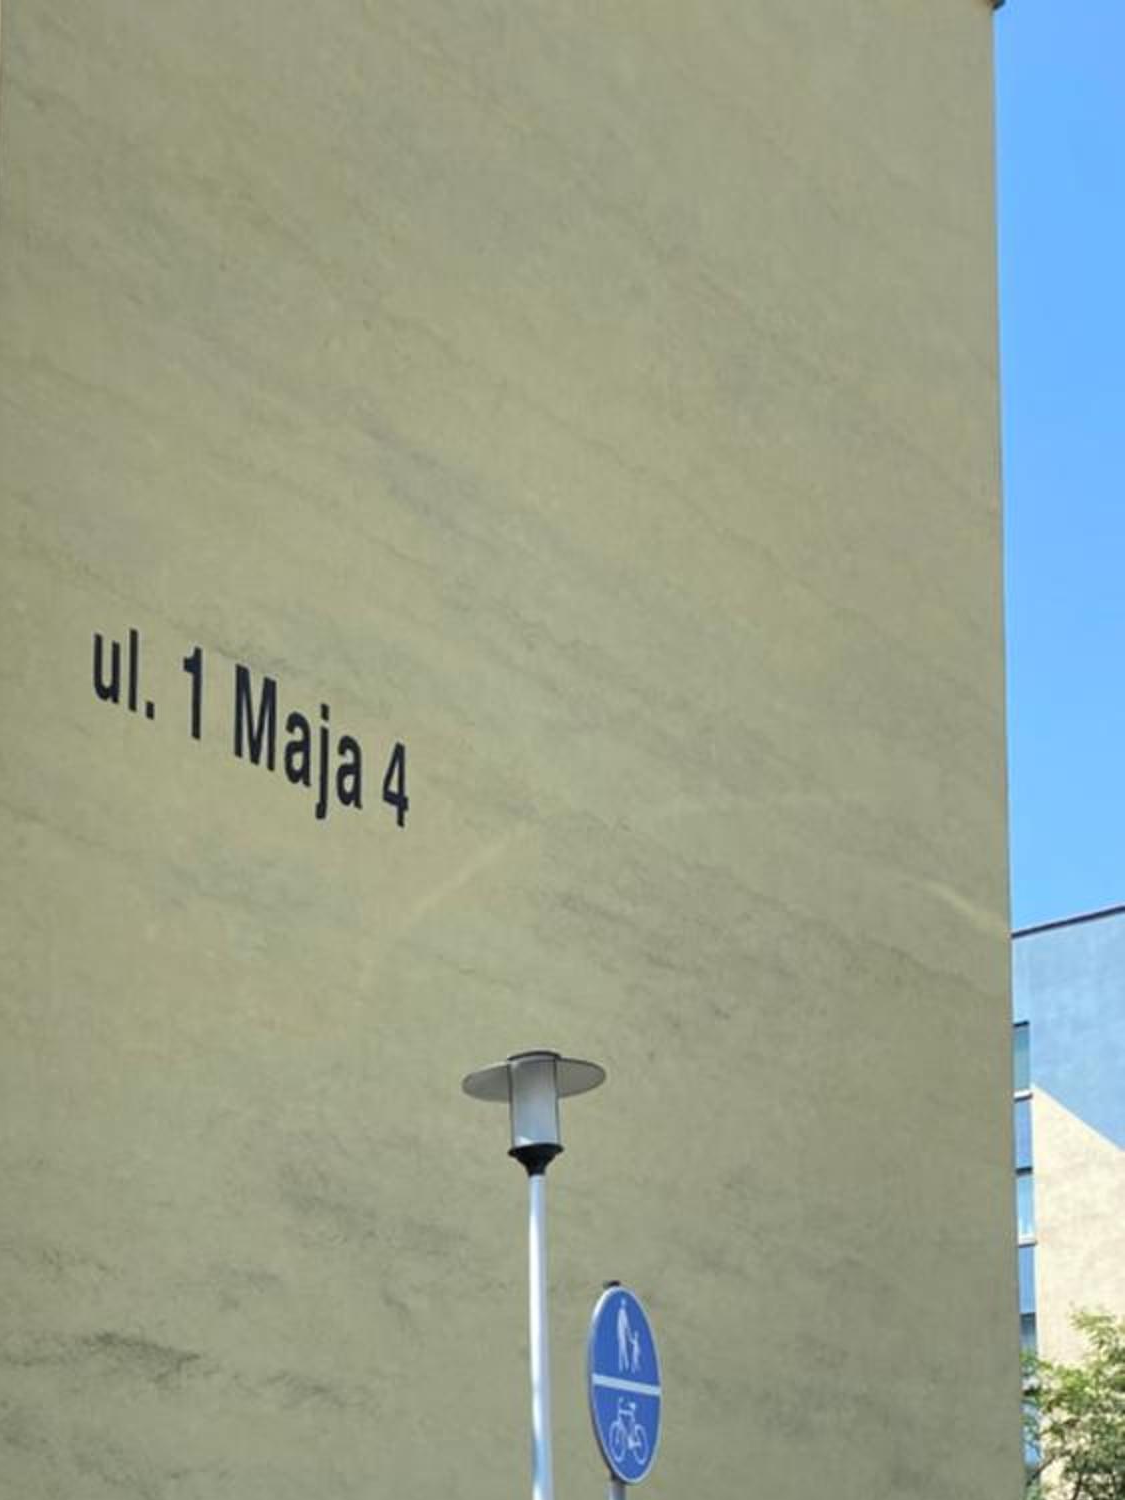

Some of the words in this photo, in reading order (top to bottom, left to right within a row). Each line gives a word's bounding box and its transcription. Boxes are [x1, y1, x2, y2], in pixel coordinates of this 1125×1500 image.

[93, 628, 155, 721] ul.
[182, 645, 203, 741] 1
[233, 662, 363, 821] Maja
[382, 741, 409, 828] 4
